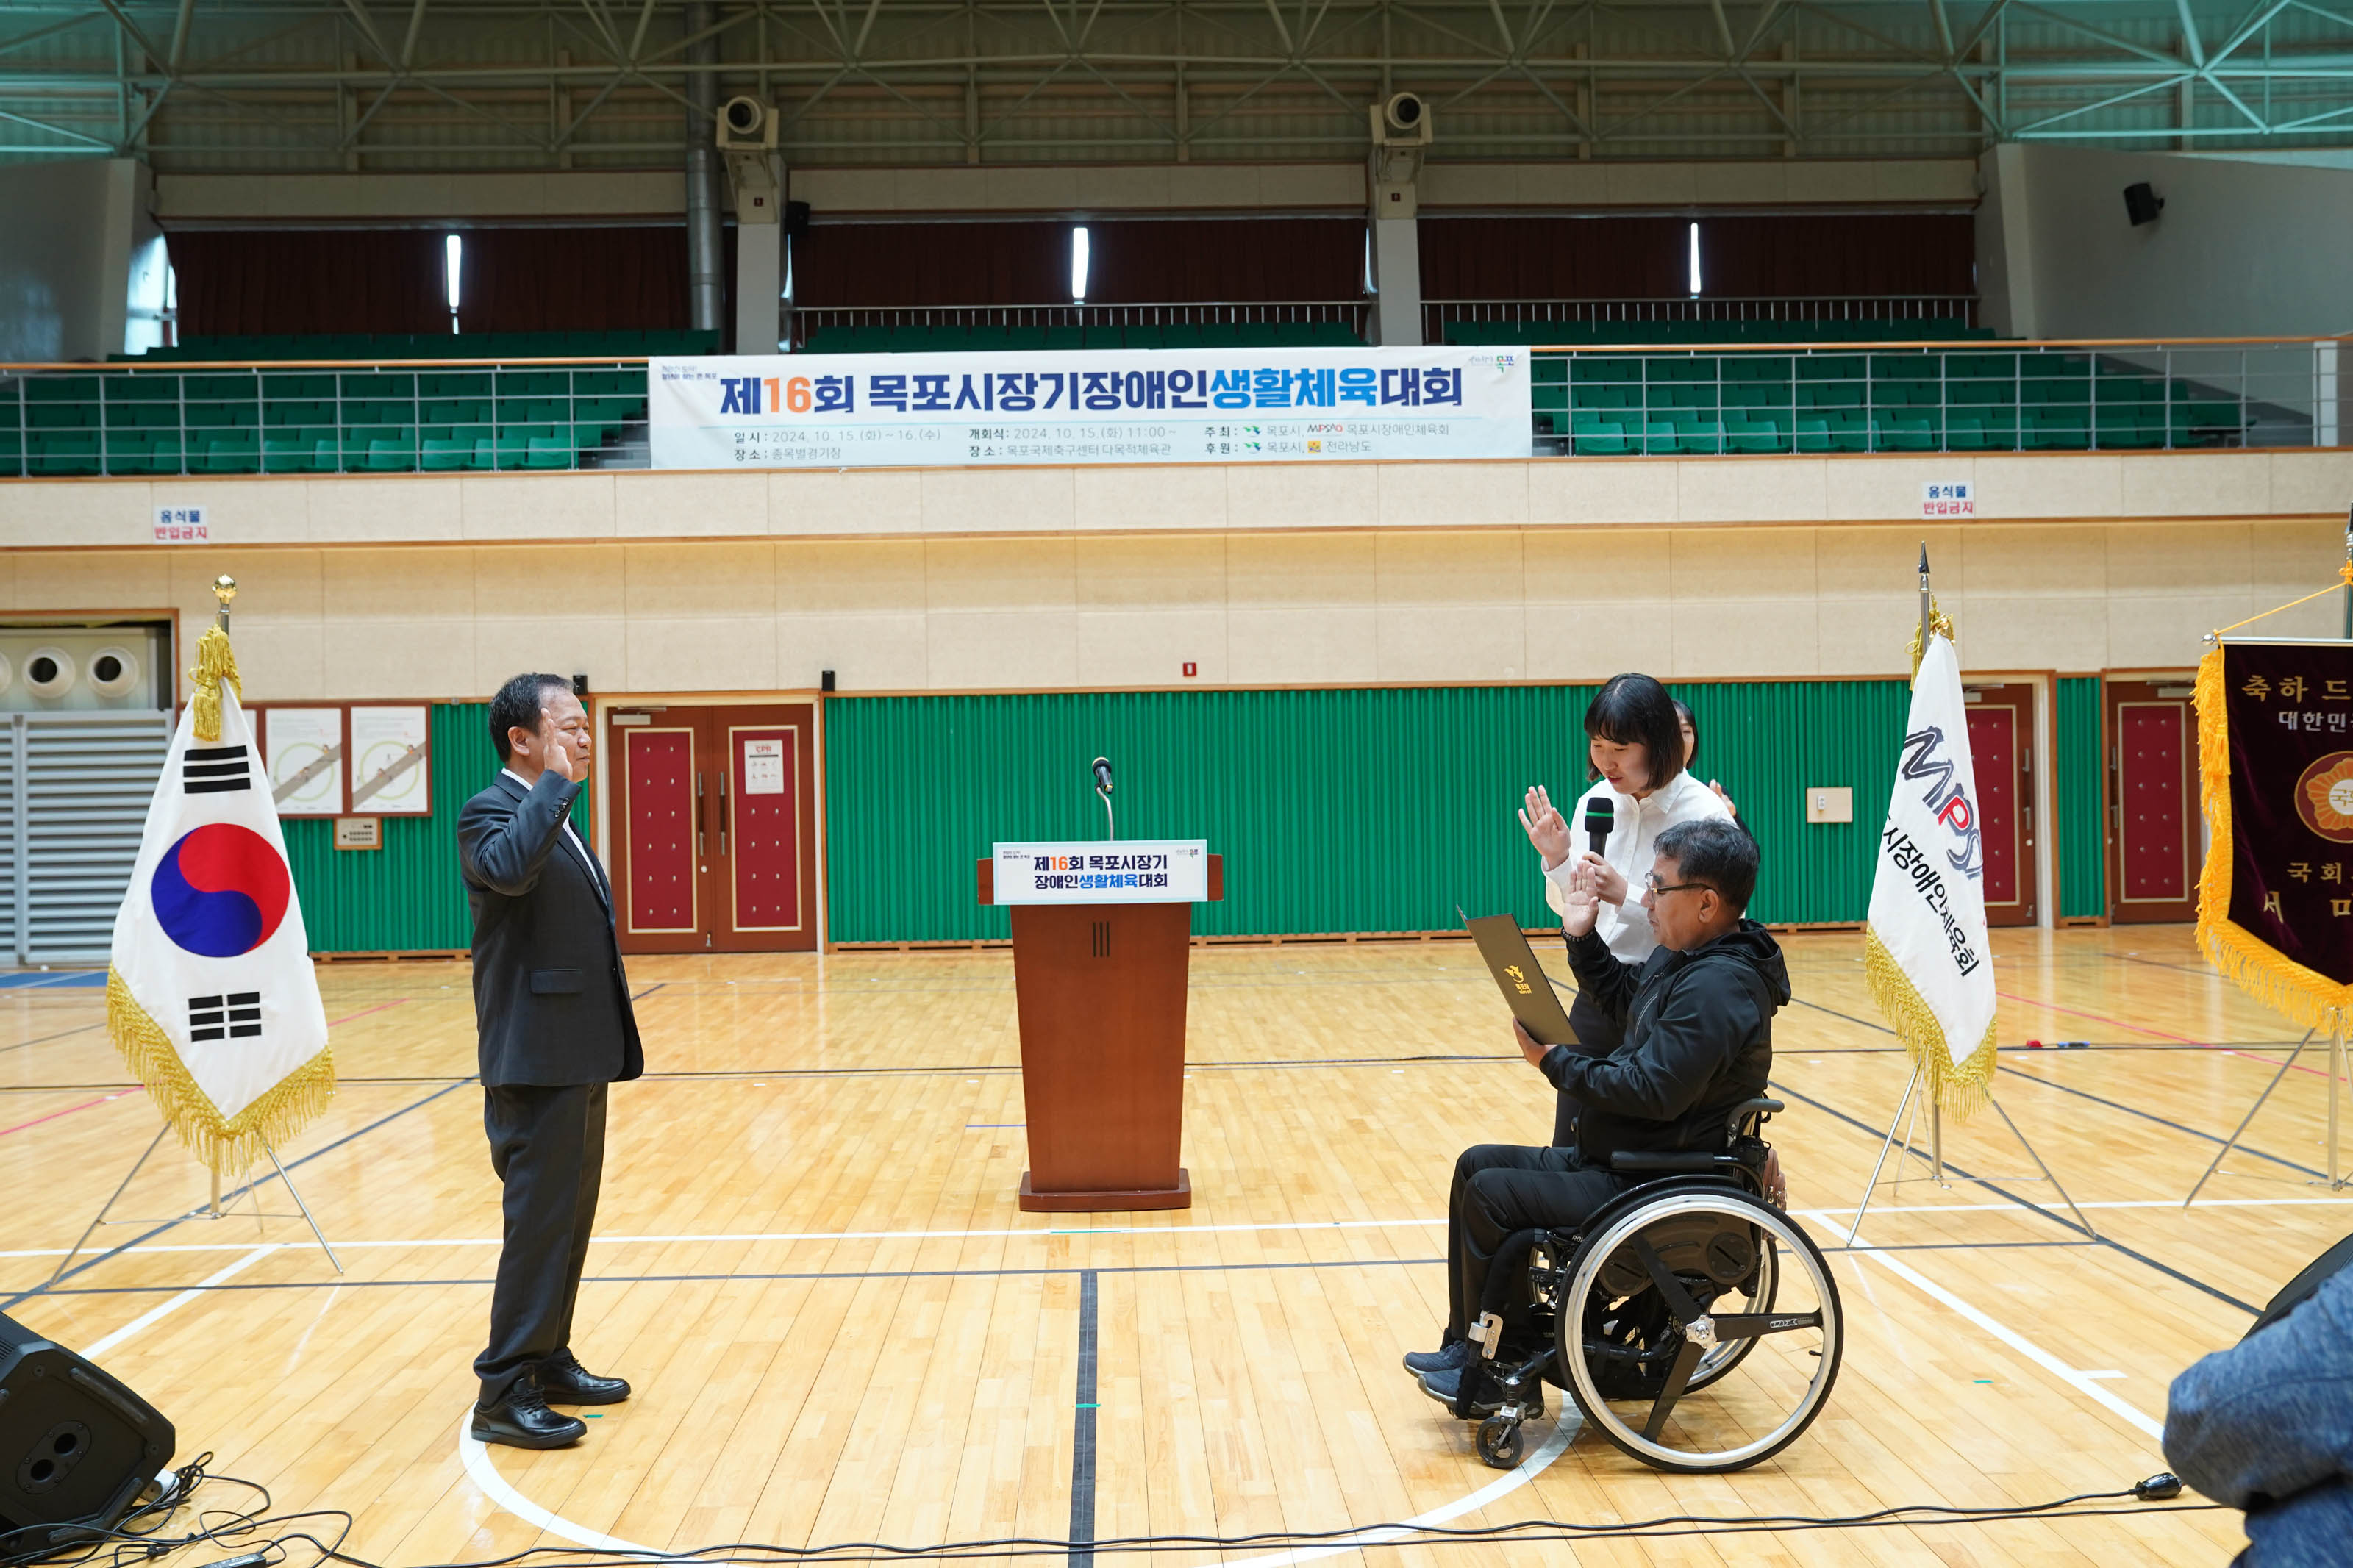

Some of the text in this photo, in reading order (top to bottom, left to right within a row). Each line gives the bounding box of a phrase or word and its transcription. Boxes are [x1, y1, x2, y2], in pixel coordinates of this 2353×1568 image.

[720, 368, 1462, 415] 제16회 목포시장기장애인생활체육대회
[773, 431, 809, 443] 2024.
[815, 430, 834, 442] 10.
[1014, 427, 1051, 440] 2024.
[1056, 427, 1075, 439] 10.
[1346, 423, 1449, 436] 목포시장애인체육회
[772, 447, 841, 461] 종목별경기장
[1327, 440, 1371, 454] 전라남도
[1923, 501, 1974, 515] 반입금지
[154, 526, 208, 540] 반입금지
[2241, 675, 2309, 704] 축하
[2279, 711, 2353, 733] 대한민
[1902, 726, 1983, 880] MPS
[1034, 854, 1168, 872] 제16회 목포시장기
[1035, 873, 1168, 889] 장애인생활체육대회
[2287, 862, 2353, 884] 국회
[1882, 814, 1979, 978] 시장애인체육회
